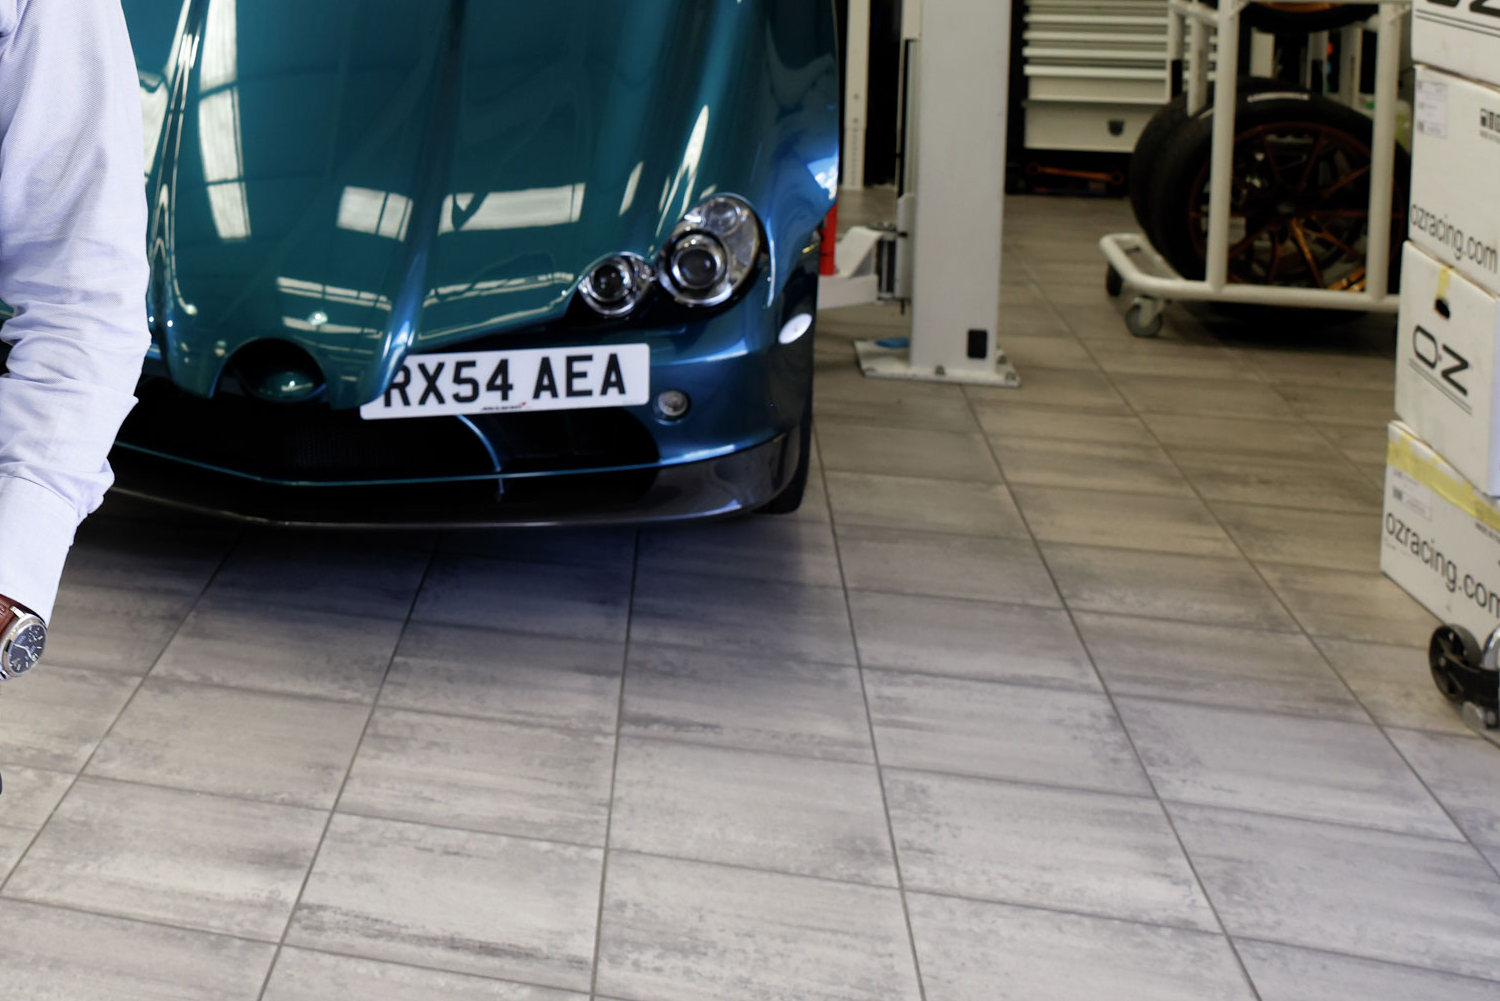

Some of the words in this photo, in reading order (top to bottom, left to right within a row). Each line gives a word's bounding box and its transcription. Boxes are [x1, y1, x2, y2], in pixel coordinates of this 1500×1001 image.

[1410, 203, 1498, 274] ozracing.com
[383, 359, 514, 408] RX54
[532, 352, 627, 400] AEA
